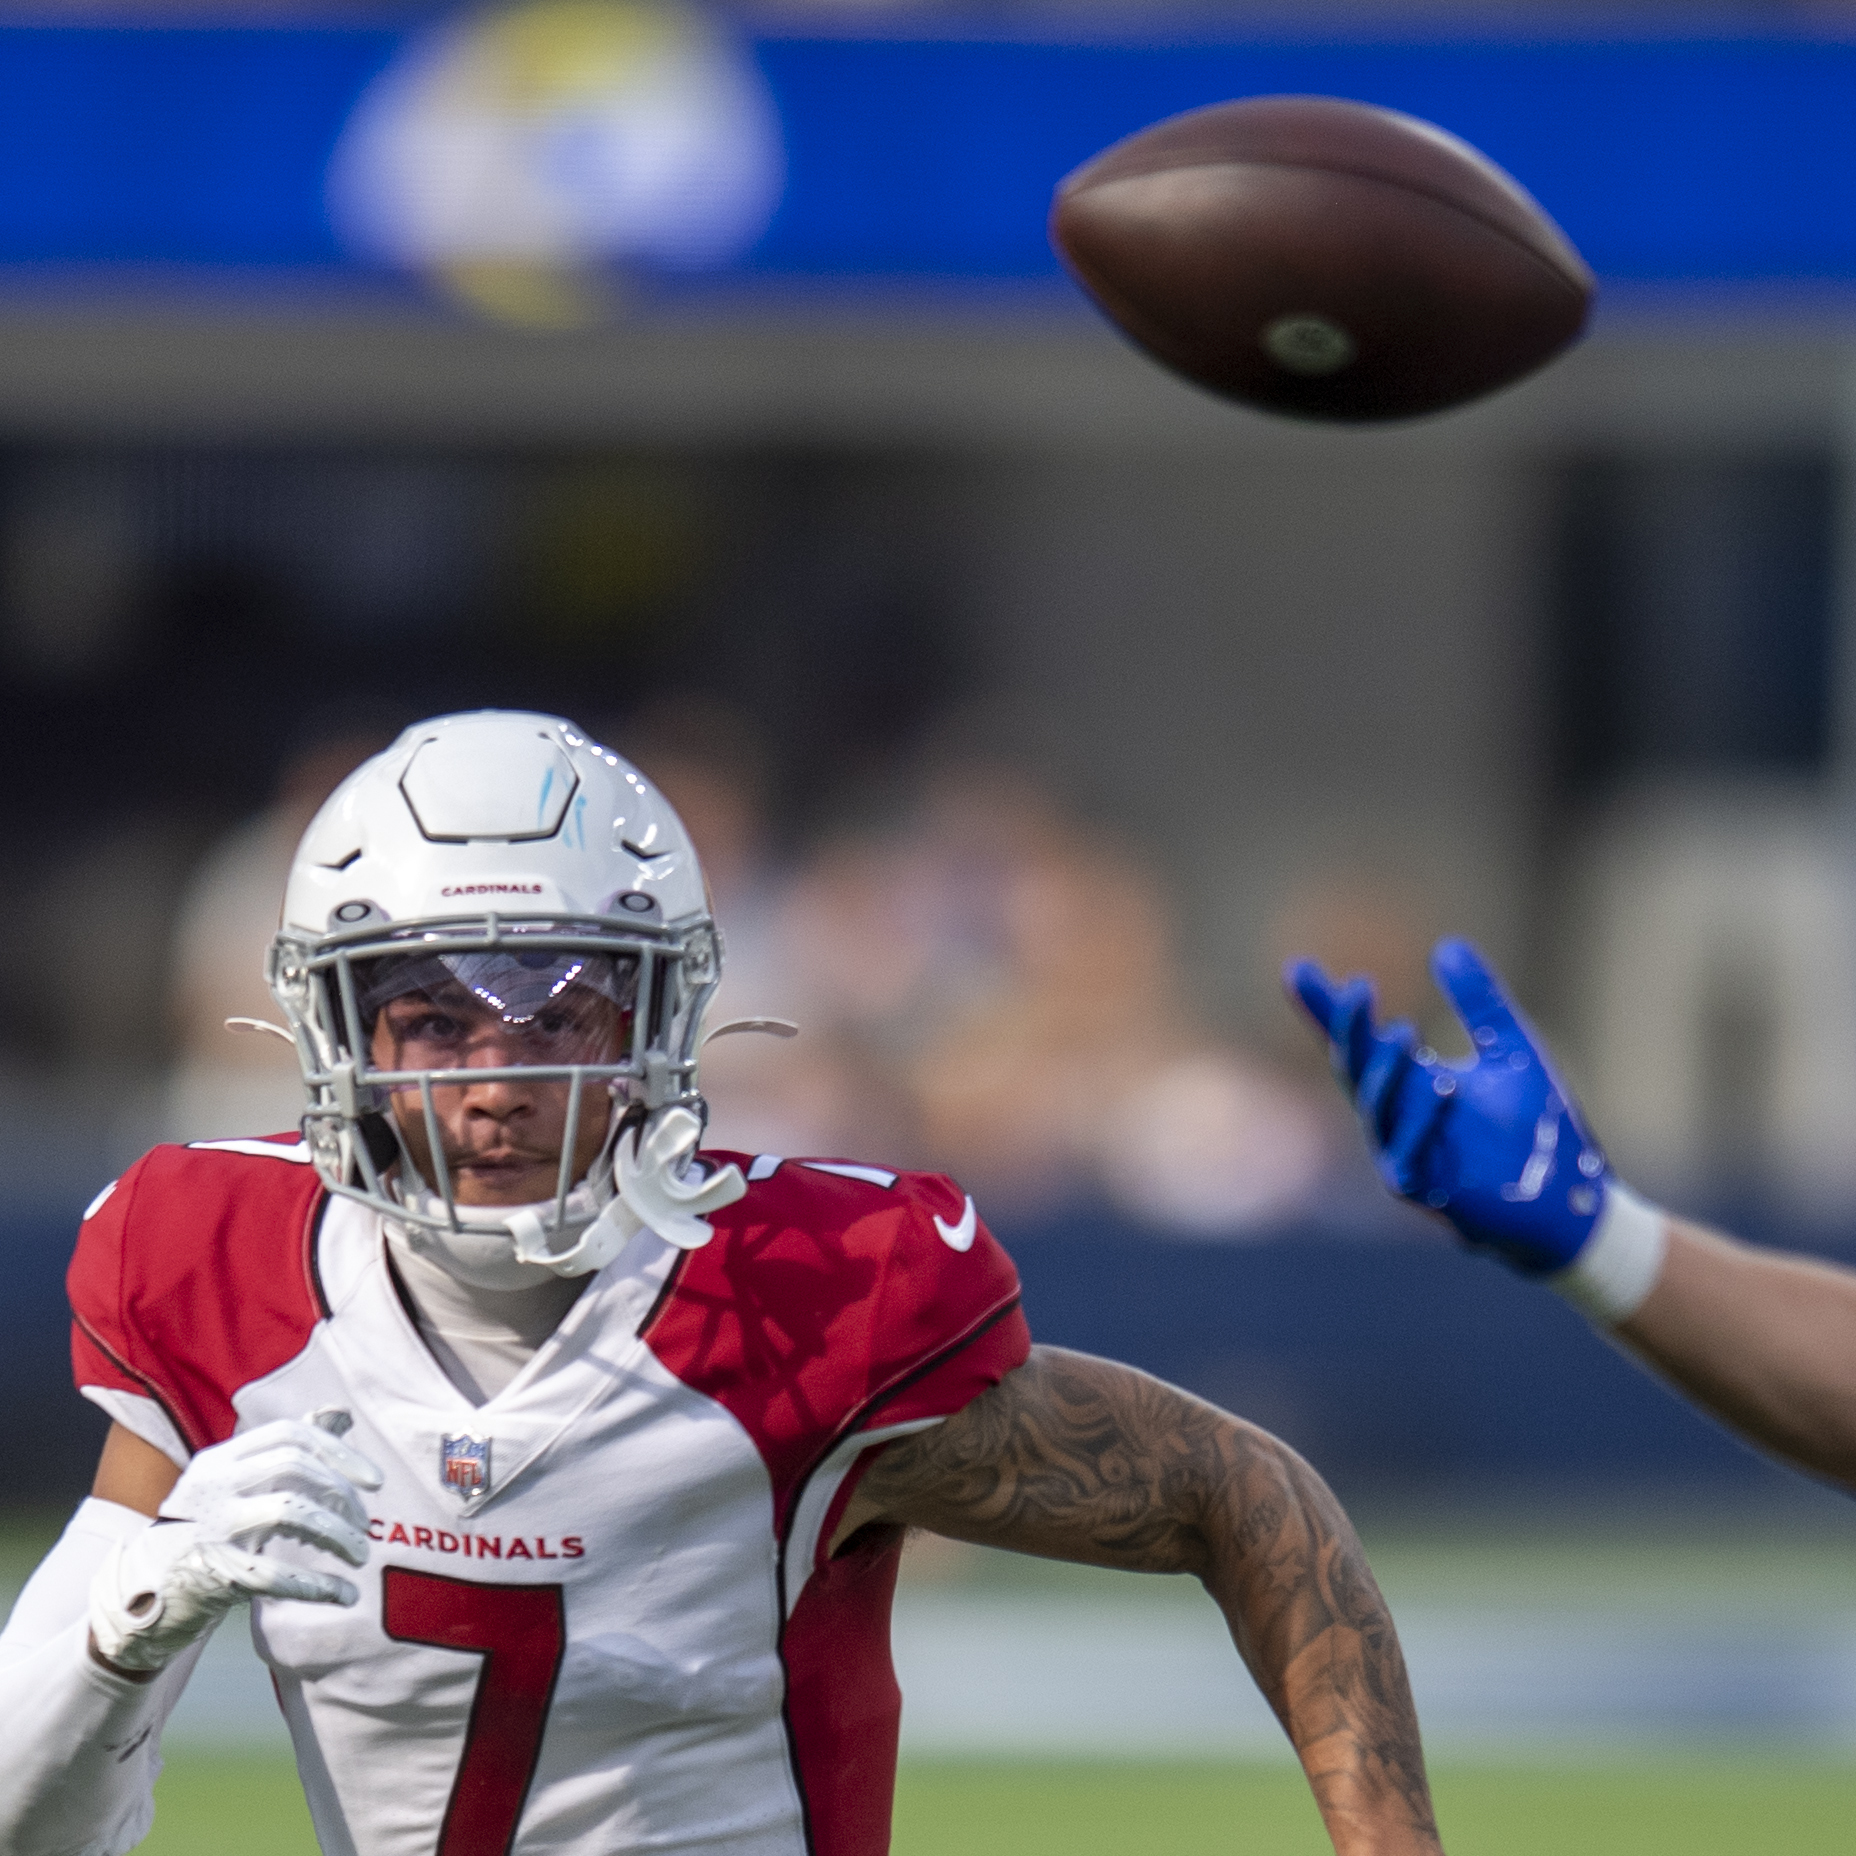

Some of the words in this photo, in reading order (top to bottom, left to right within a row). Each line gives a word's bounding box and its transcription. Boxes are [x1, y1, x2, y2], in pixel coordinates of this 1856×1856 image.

[441, 883, 542, 897] CARDINALS
[446, 1459, 482, 1487] NFL
[367, 1518, 586, 1560] CARDINALS
